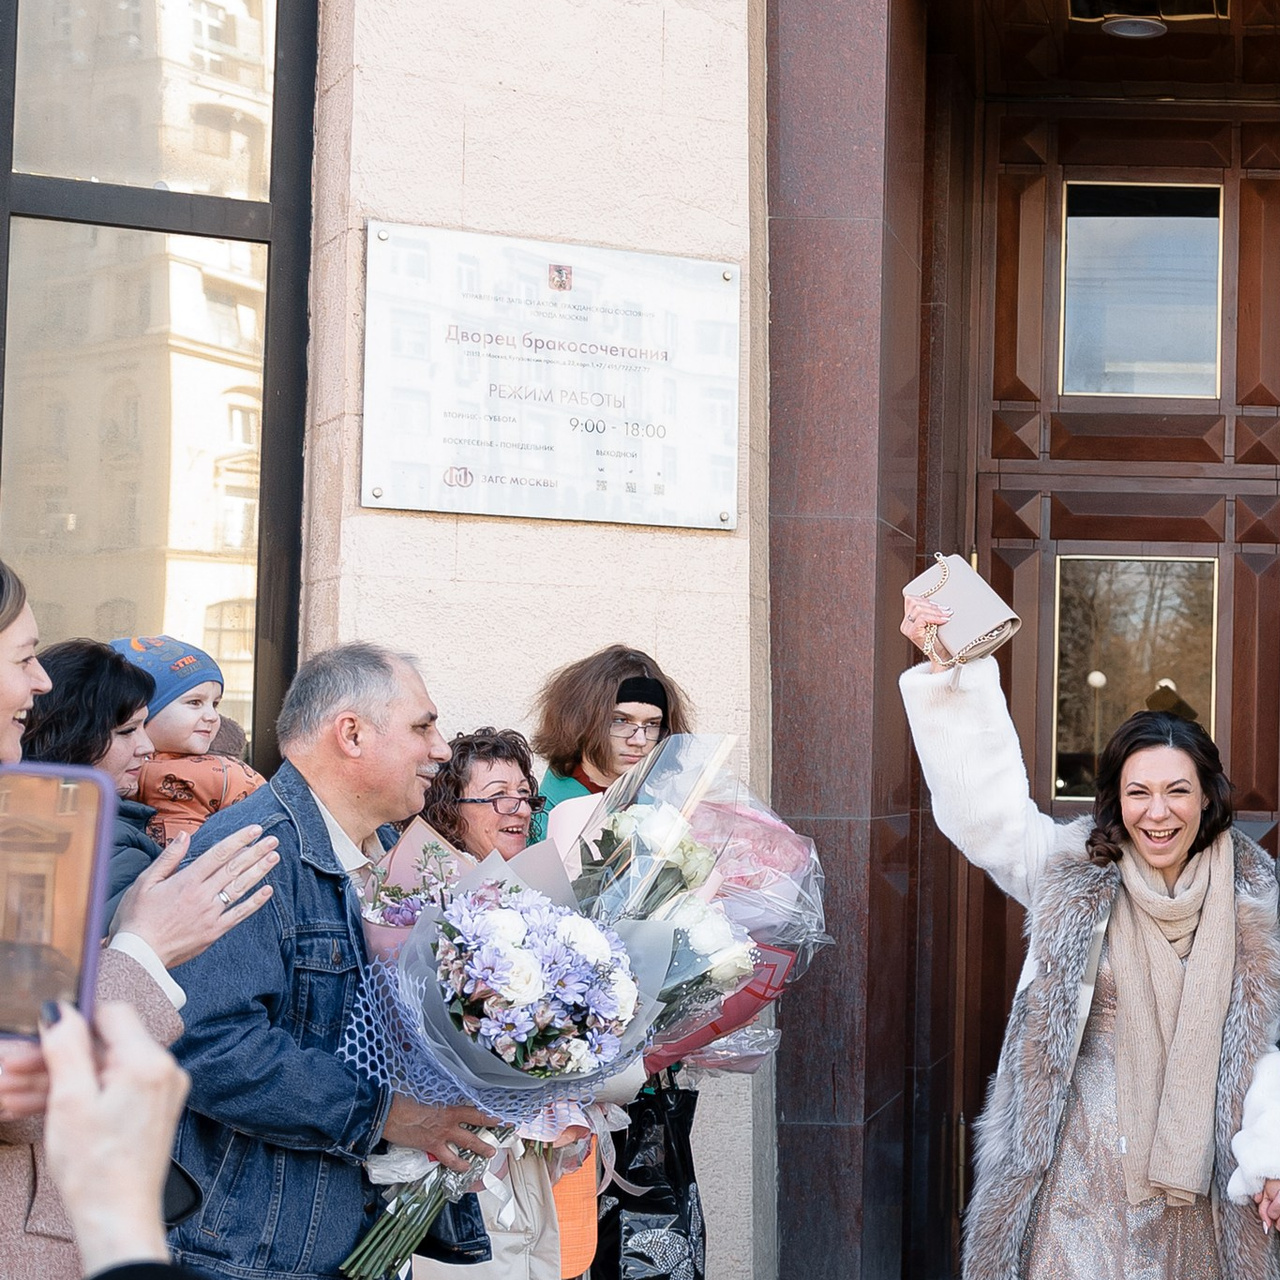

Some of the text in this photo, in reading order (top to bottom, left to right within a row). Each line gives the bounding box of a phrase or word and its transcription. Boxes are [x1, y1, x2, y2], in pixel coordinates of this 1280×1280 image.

[445, 324, 668, 361] Дворец бракосочетания
[489, 383, 626, 409] РЕЖИМ РАБОТЫ
[483, 414, 517, 423] СУББОТА
[569, 417, 606, 434] 9:00
[624, 422, 666, 439] 18:00
[481, 474, 559, 489] ЗАГС МОСКВЫ
